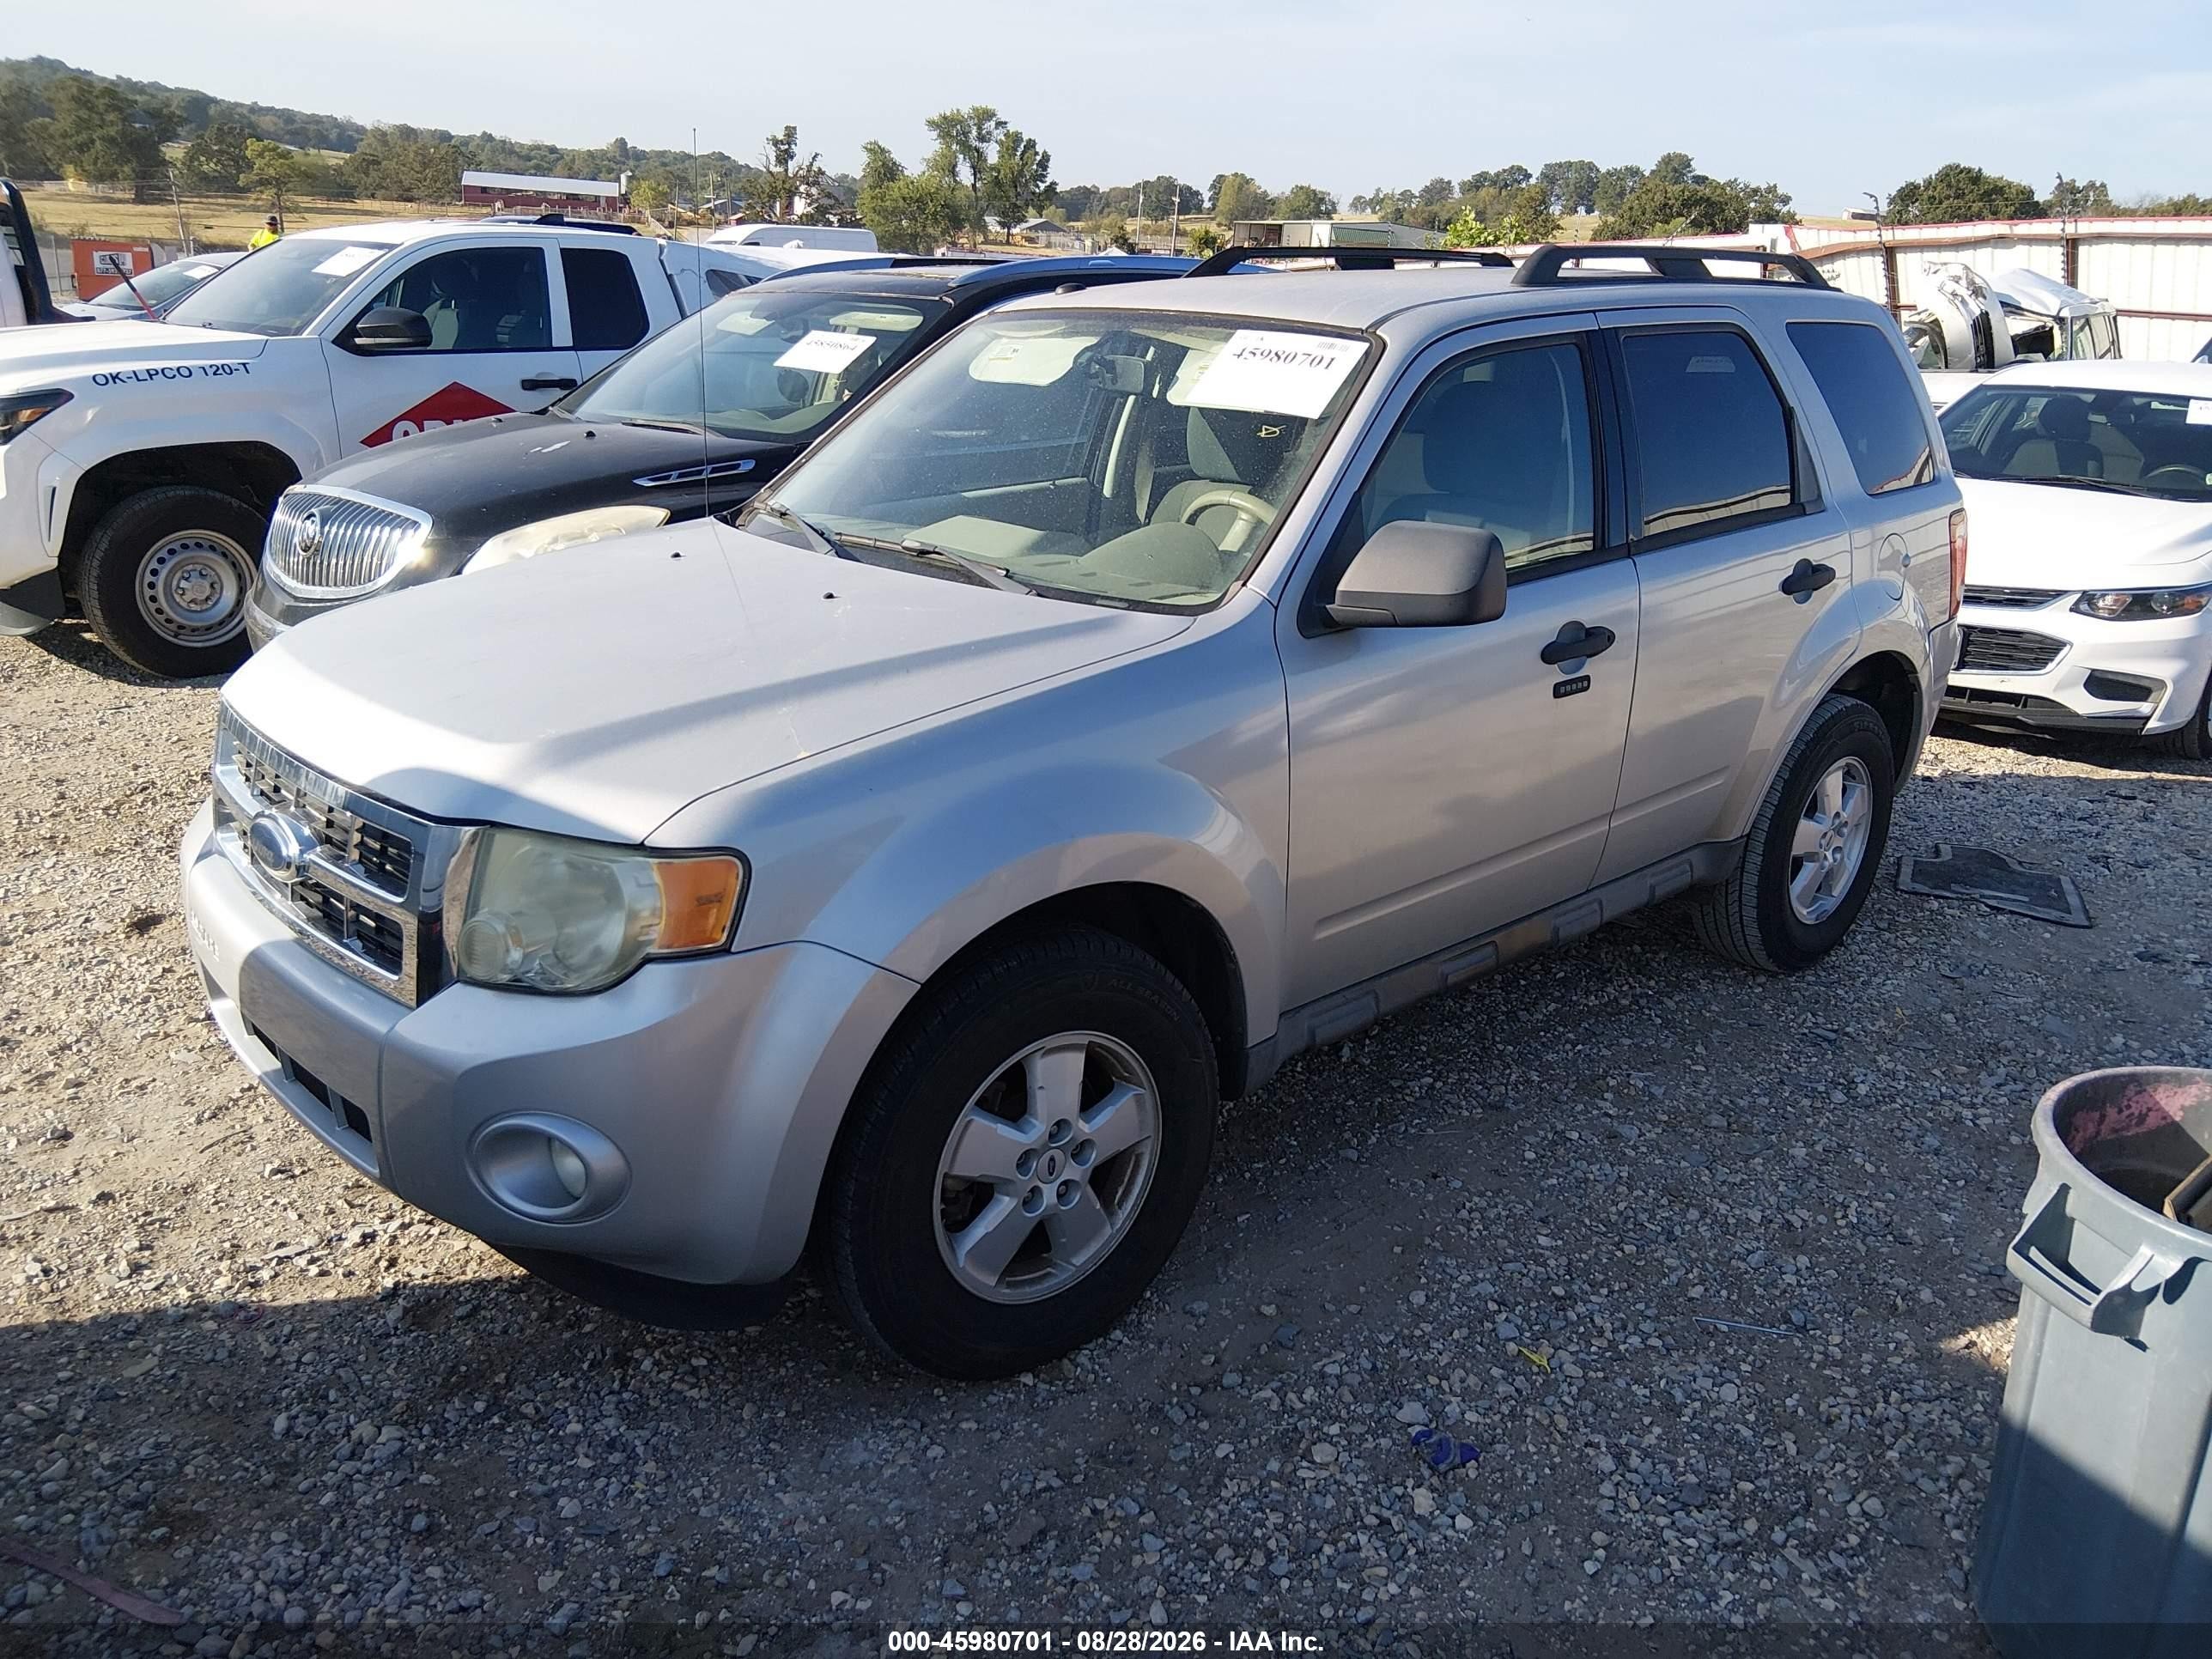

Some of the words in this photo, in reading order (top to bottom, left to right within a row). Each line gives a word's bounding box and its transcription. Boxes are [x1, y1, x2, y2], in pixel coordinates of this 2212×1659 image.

[1232, 347, 1338, 371] 45980701
[92, 365, 193, 386] OK-LPCO
[198, 362, 251, 377] 120-T
